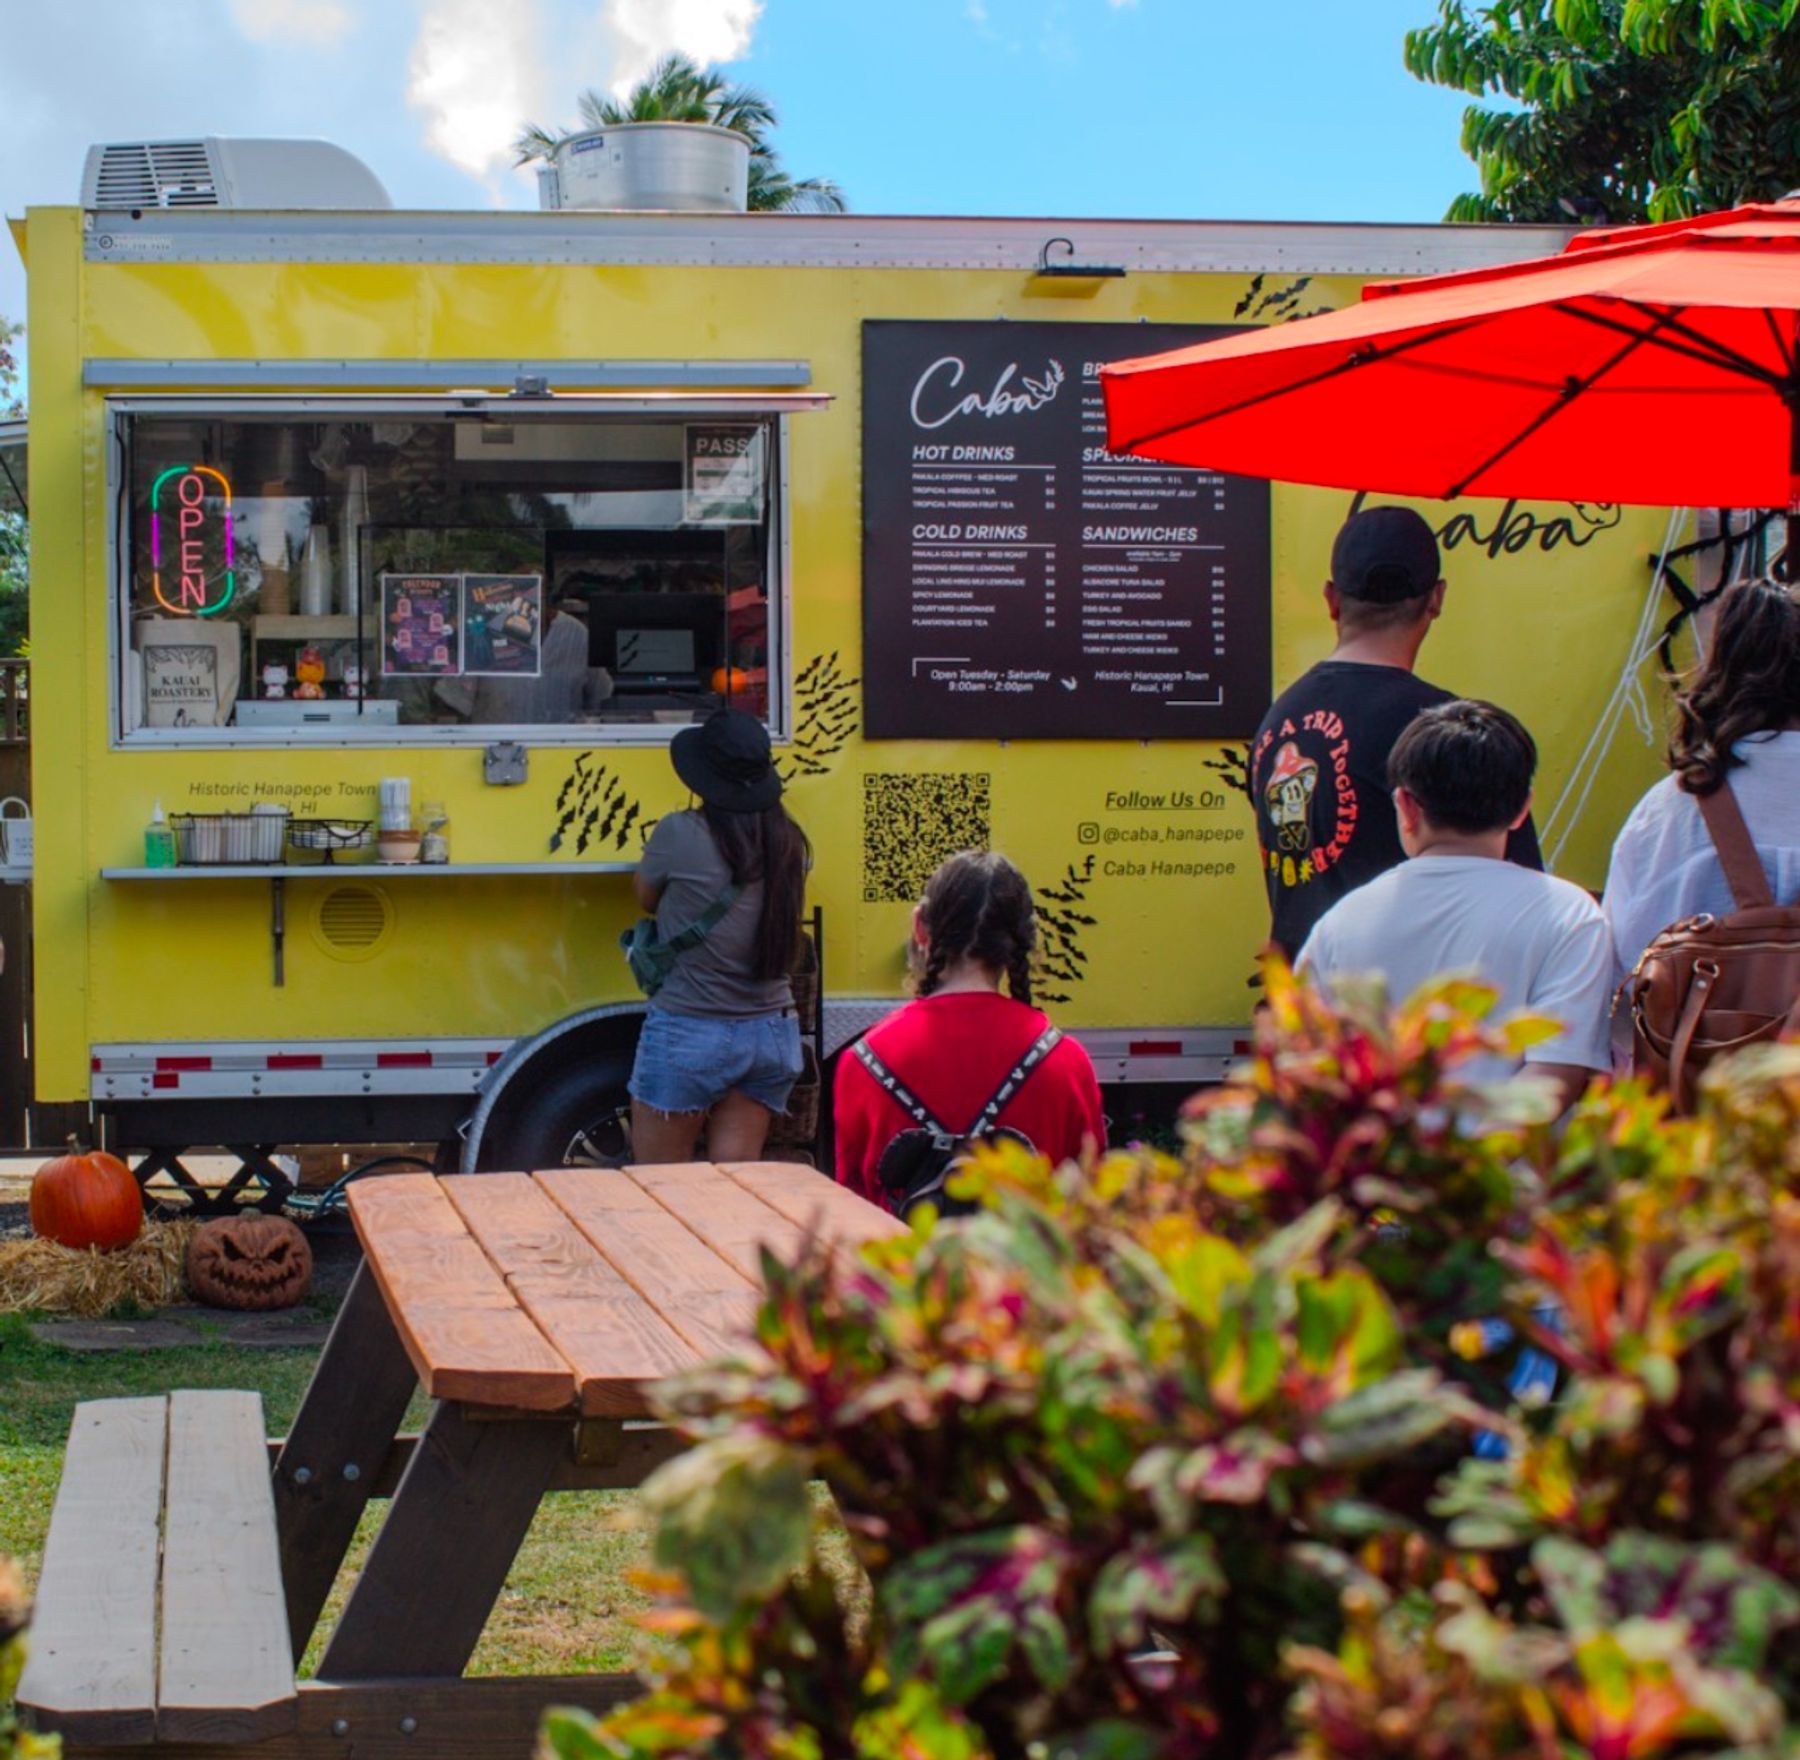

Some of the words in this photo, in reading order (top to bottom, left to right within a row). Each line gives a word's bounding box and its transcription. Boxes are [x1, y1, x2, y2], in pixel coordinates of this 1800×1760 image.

[911, 356, 1048, 429] Caba
[695, 436, 748, 454] PASS
[912, 446, 950, 460] HOT
[952, 446, 1015, 461] DRINKS
[178, 474, 206, 607] OPEN
[912, 525, 961, 539] COLD
[965, 525, 1028, 539] DRINKS
[1082, 526, 1199, 541] SANDWICHES
[931, 670, 958, 680] Open
[960, 670, 999, 681] Tuesday
[1007, 670, 1051, 681] Saturday
[1094, 670, 1132, 680] Historic
[1134, 670, 1184, 682] Hanapepe
[1185, 670, 1210, 680] Town
[150, 688, 211, 698] ROASTERY
[1279, 718, 1297, 738] A
[1302, 709, 1344, 740] TRIP
[189, 782, 249, 796] Historic
[254, 782, 332, 798] Hanapepe
[338, 782, 377, 796] Town
[1105, 792, 1166, 808] Follow
[1171, 792, 1194, 808] Us
[1200, 791, 1225, 807] On
[1311, 739, 1359, 873] TOGETHER
[1104, 826, 1244, 844] @caba_hanapepe
[1104, 860, 1146, 876] Caba
[1151, 860, 1236, 878] Hanapepe
